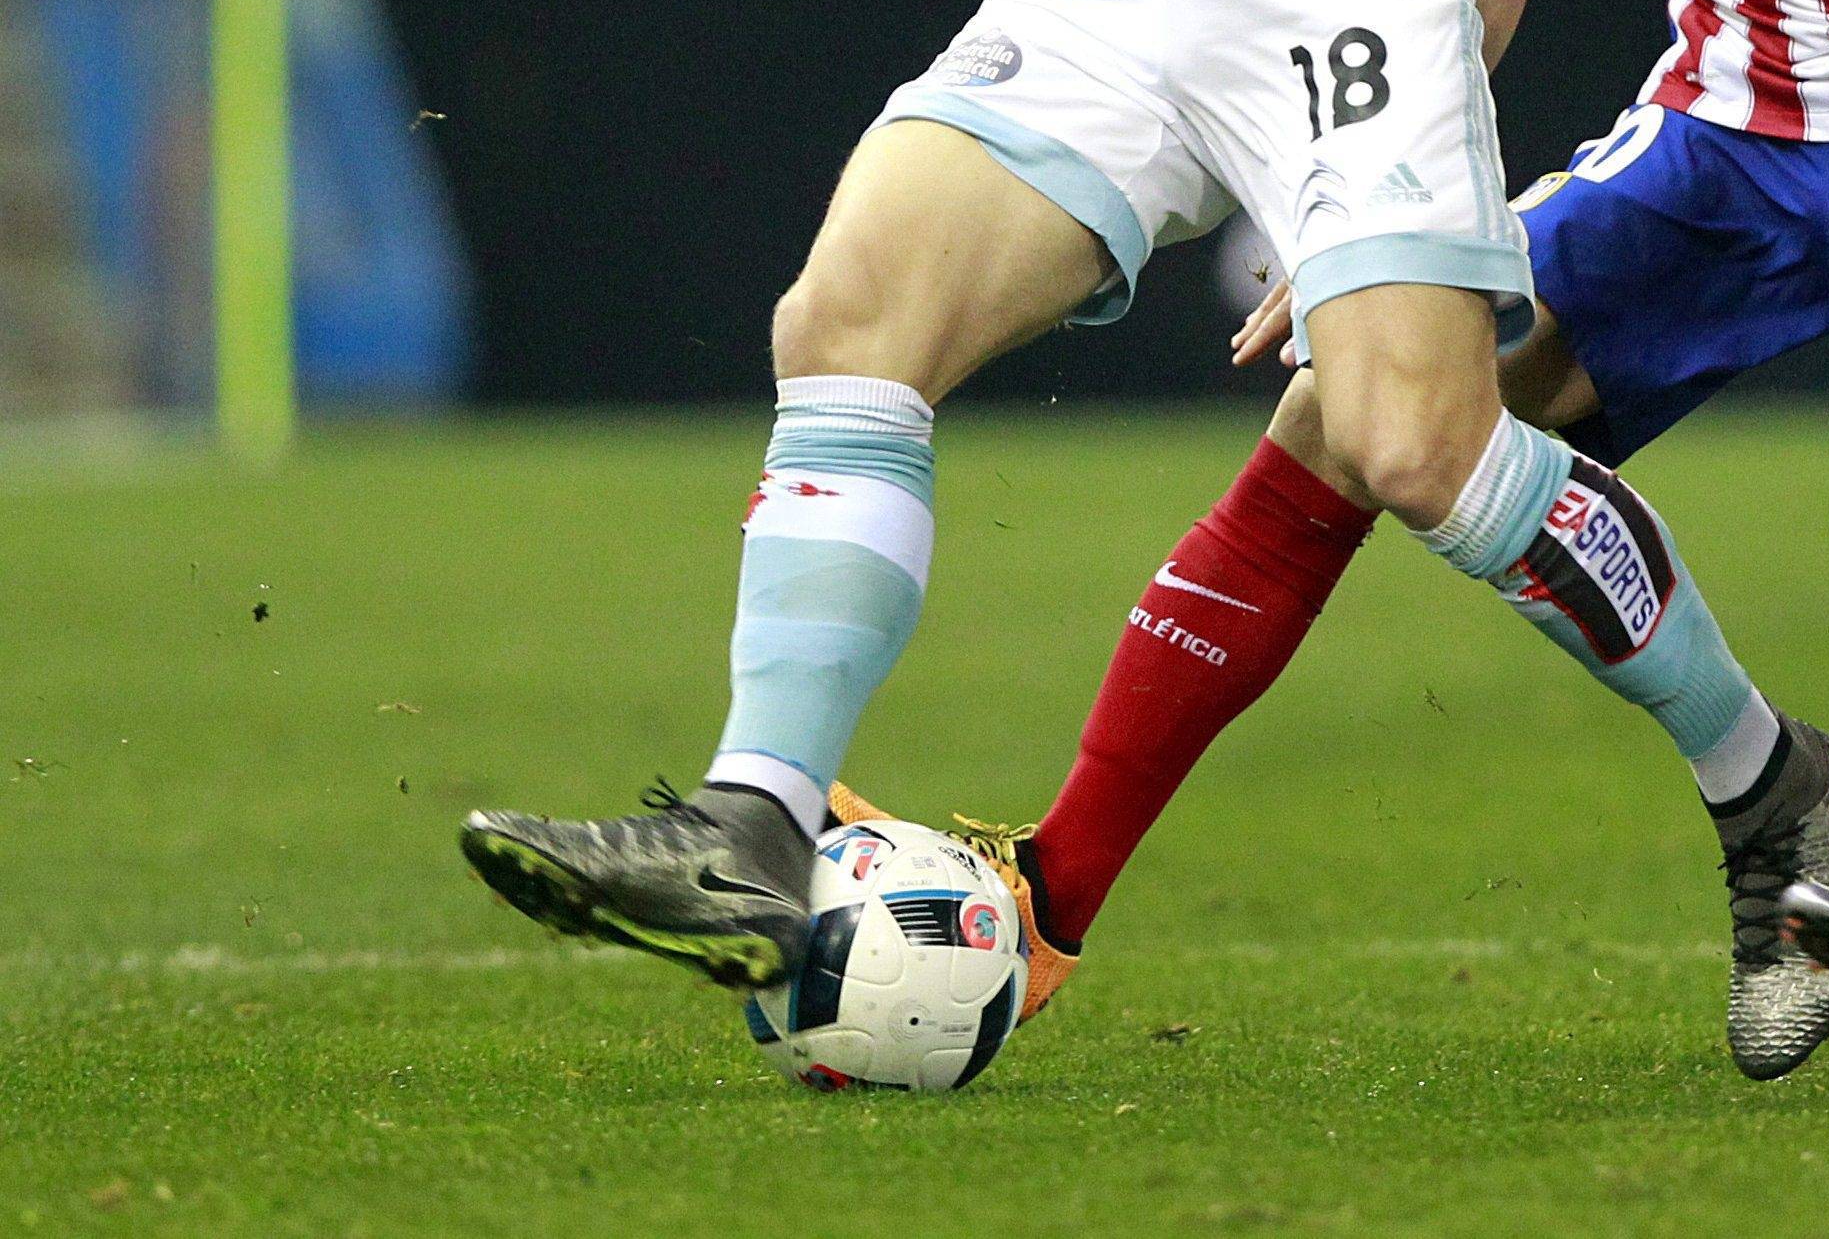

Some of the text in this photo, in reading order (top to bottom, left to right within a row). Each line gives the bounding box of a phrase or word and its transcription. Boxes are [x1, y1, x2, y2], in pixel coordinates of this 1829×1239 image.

[1289, 26, 1391, 144] 18
[1546, 490, 1655, 633] EA SPORTS
